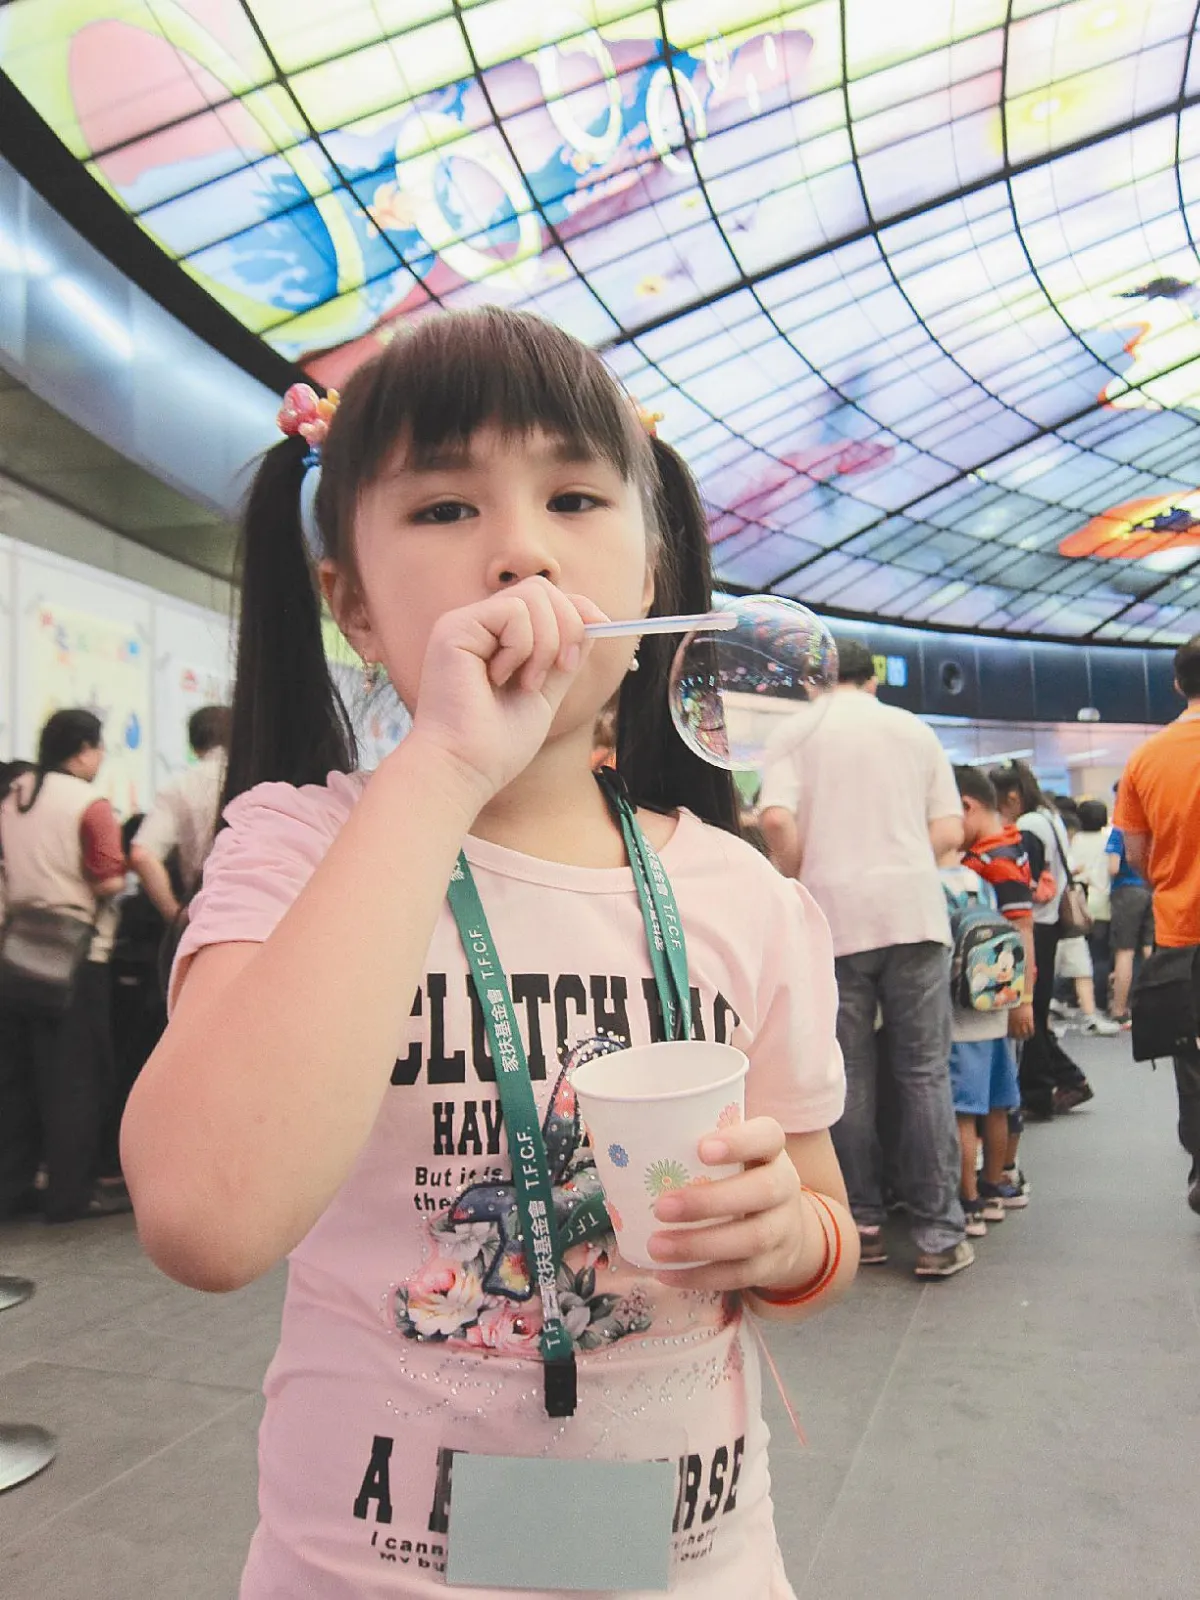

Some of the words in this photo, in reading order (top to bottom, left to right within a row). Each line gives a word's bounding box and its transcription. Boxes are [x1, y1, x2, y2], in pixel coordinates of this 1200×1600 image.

[469, 925, 496, 980] T.F.C.F.
[487, 989, 519, 1073] 家扶基金會
[433, 1099, 506, 1155] HAV
[415, 1166, 452, 1187] But
[517, 1126, 540, 1191] T.F.C.F.
[353, 1435, 394, 1524] A
[655, 1434, 745, 1533] RSE
[371, 1531, 378, 1546] I
[385, 1538, 449, 1556] cann
